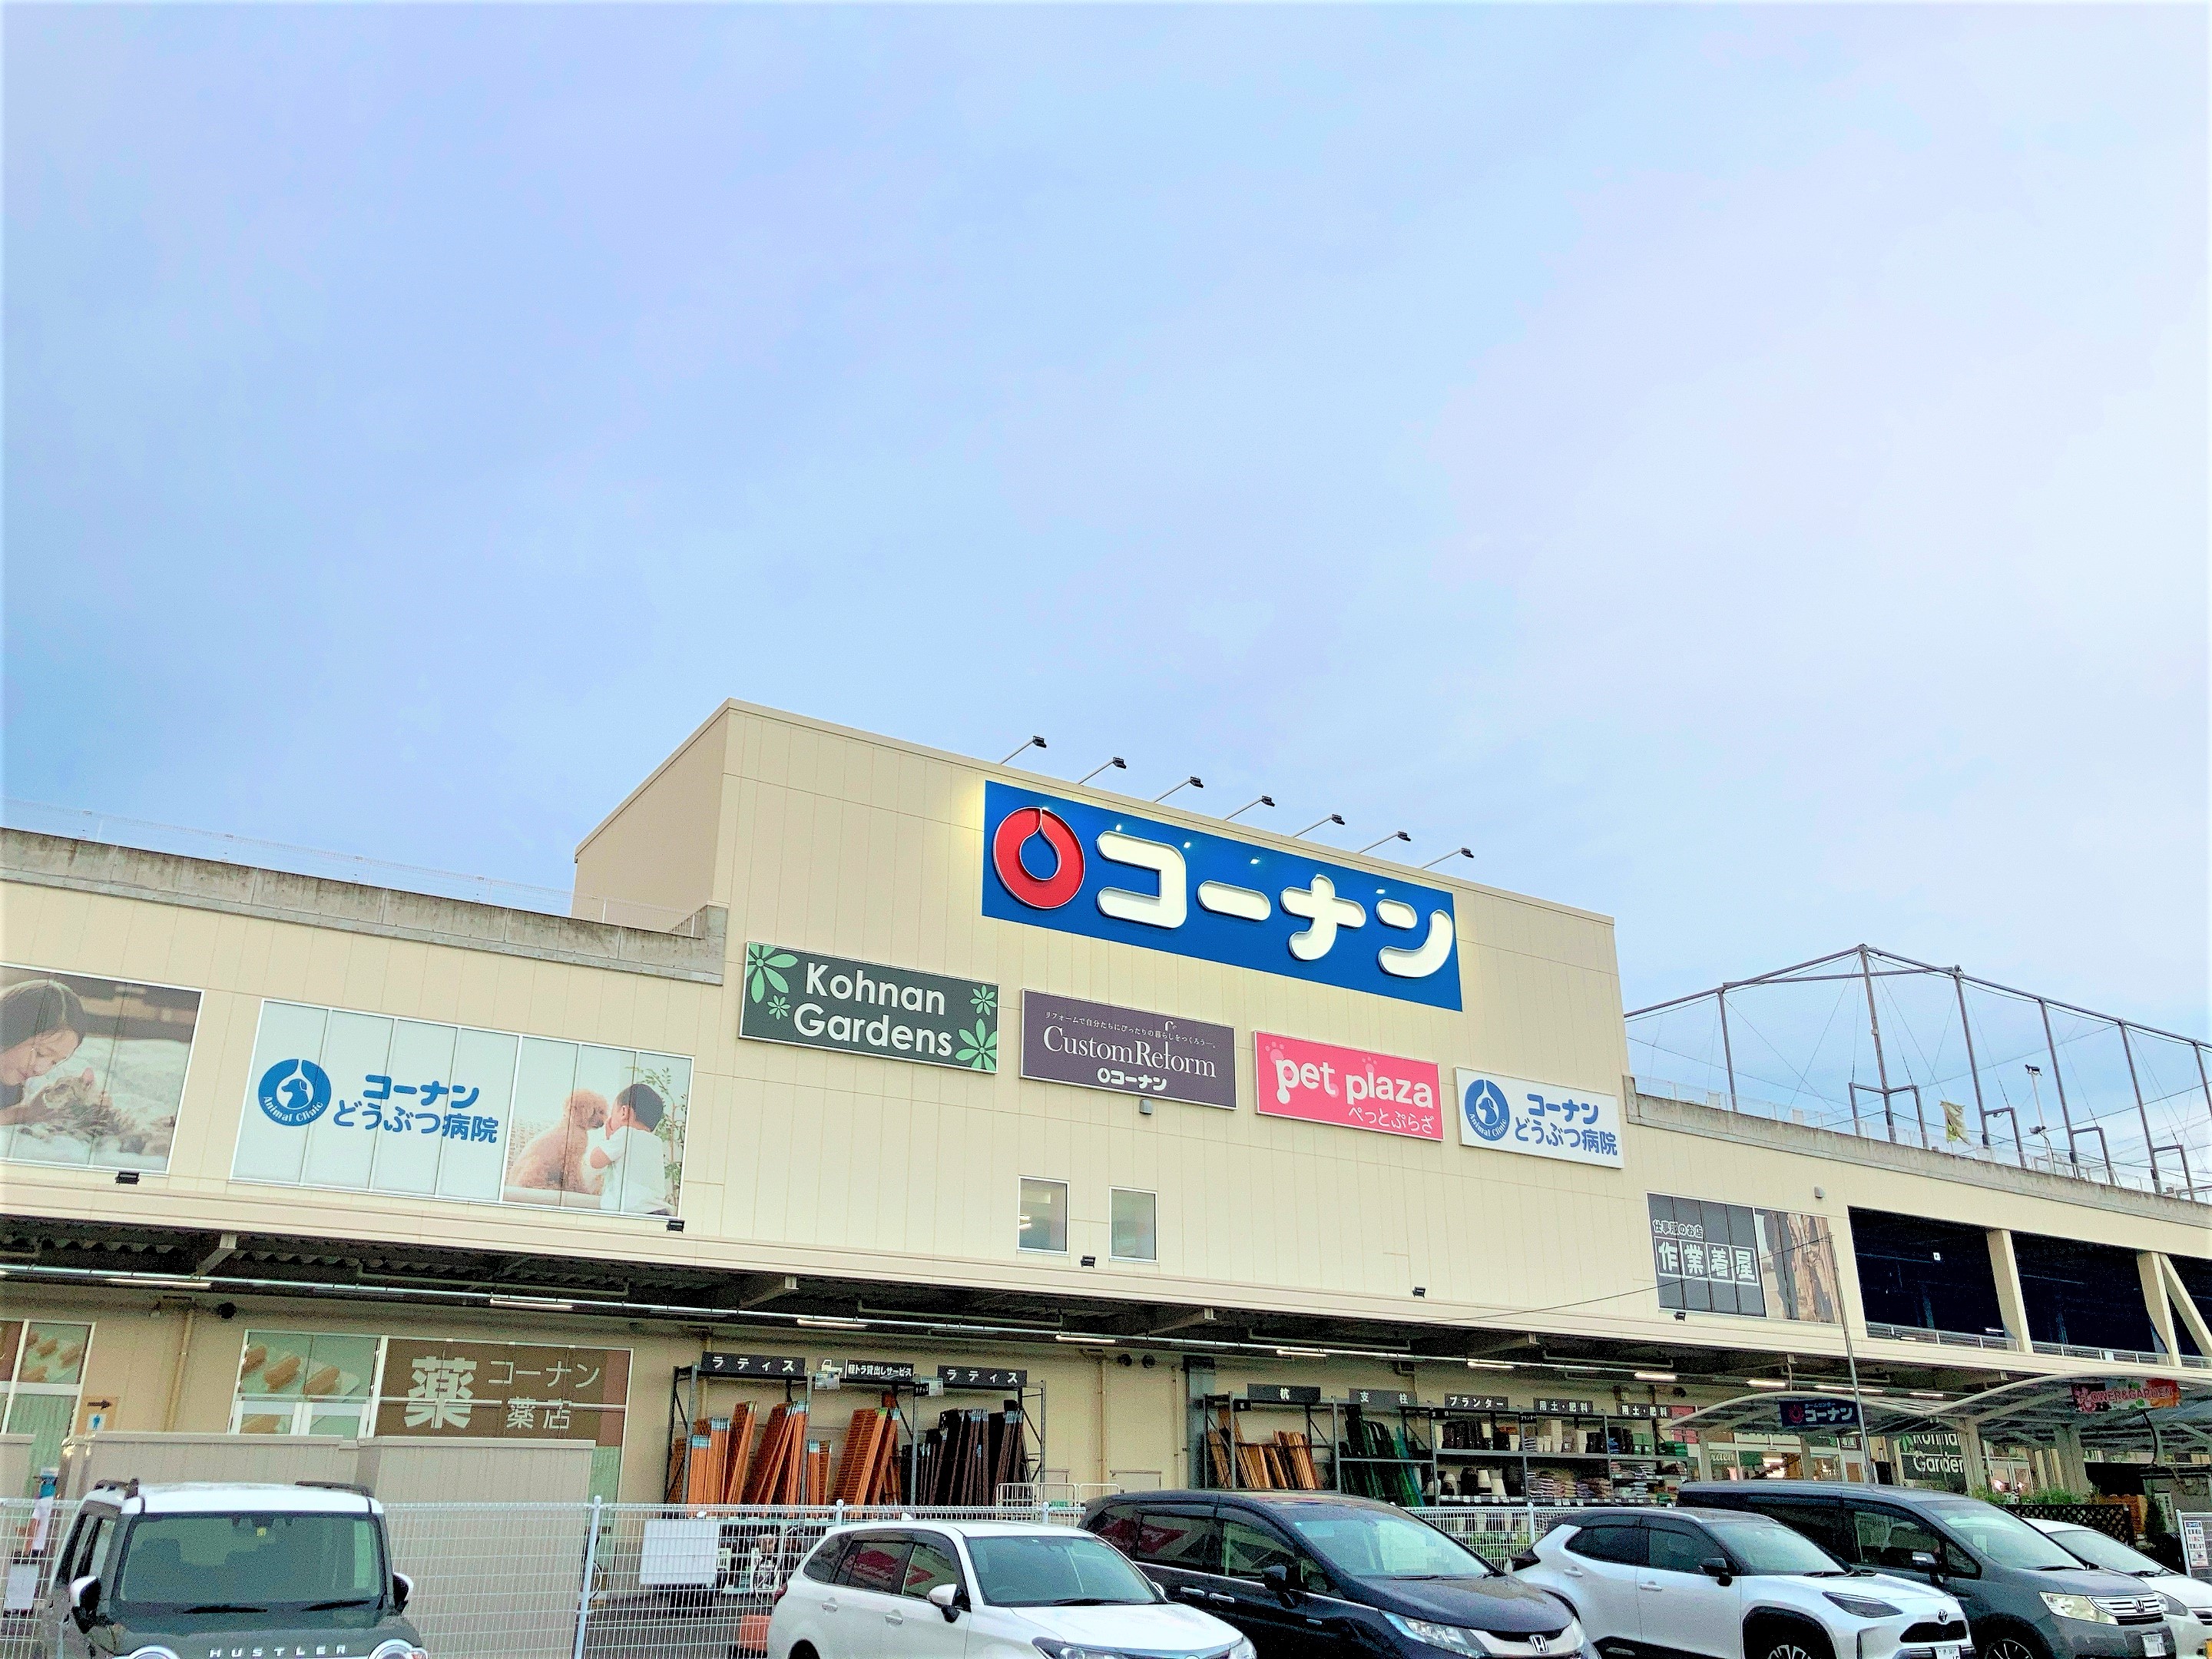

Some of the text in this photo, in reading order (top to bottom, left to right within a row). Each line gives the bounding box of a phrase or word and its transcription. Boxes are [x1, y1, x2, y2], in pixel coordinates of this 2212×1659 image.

[1097, 830, 1454, 979] コーナン
[806, 962, 945, 1016] Kohnan
[793, 1002, 952, 1057] Gardens
[1043, 1021, 1217, 1078] CustomReform
[363, 1074, 480, 1109] コーナン
[1111, 1070, 1167, 1091] コーナン
[1275, 1058, 1434, 1109] pet plaza
[263, 1095, 324, 1122] Animal Clinic
[333, 1099, 499, 1144] どうぶつ病院
[1348, 1107, 1435, 1134] ぺっとぷらざ
[1469, 1112, 1507, 1137] Animal Clinic
[1527, 1093, 1599, 1124] コーナン
[1515, 1116, 1618, 1156] どうぶつ病院
[1657, 1240, 1756, 1282] 作業着屋
[488, 1360, 601, 1388] コーナン
[712, 1356, 795, 1373] ラティス
[946, 1369, 1018, 1383] ラティス
[404, 1356, 478, 1429] 薬
[1449, 1396, 1504, 1409] プランター
[506, 1396, 571, 1430] 薬店
[1804, 1407, 1853, 1422] コーナン
[209, 1644, 346, 1657] HUSTLER
